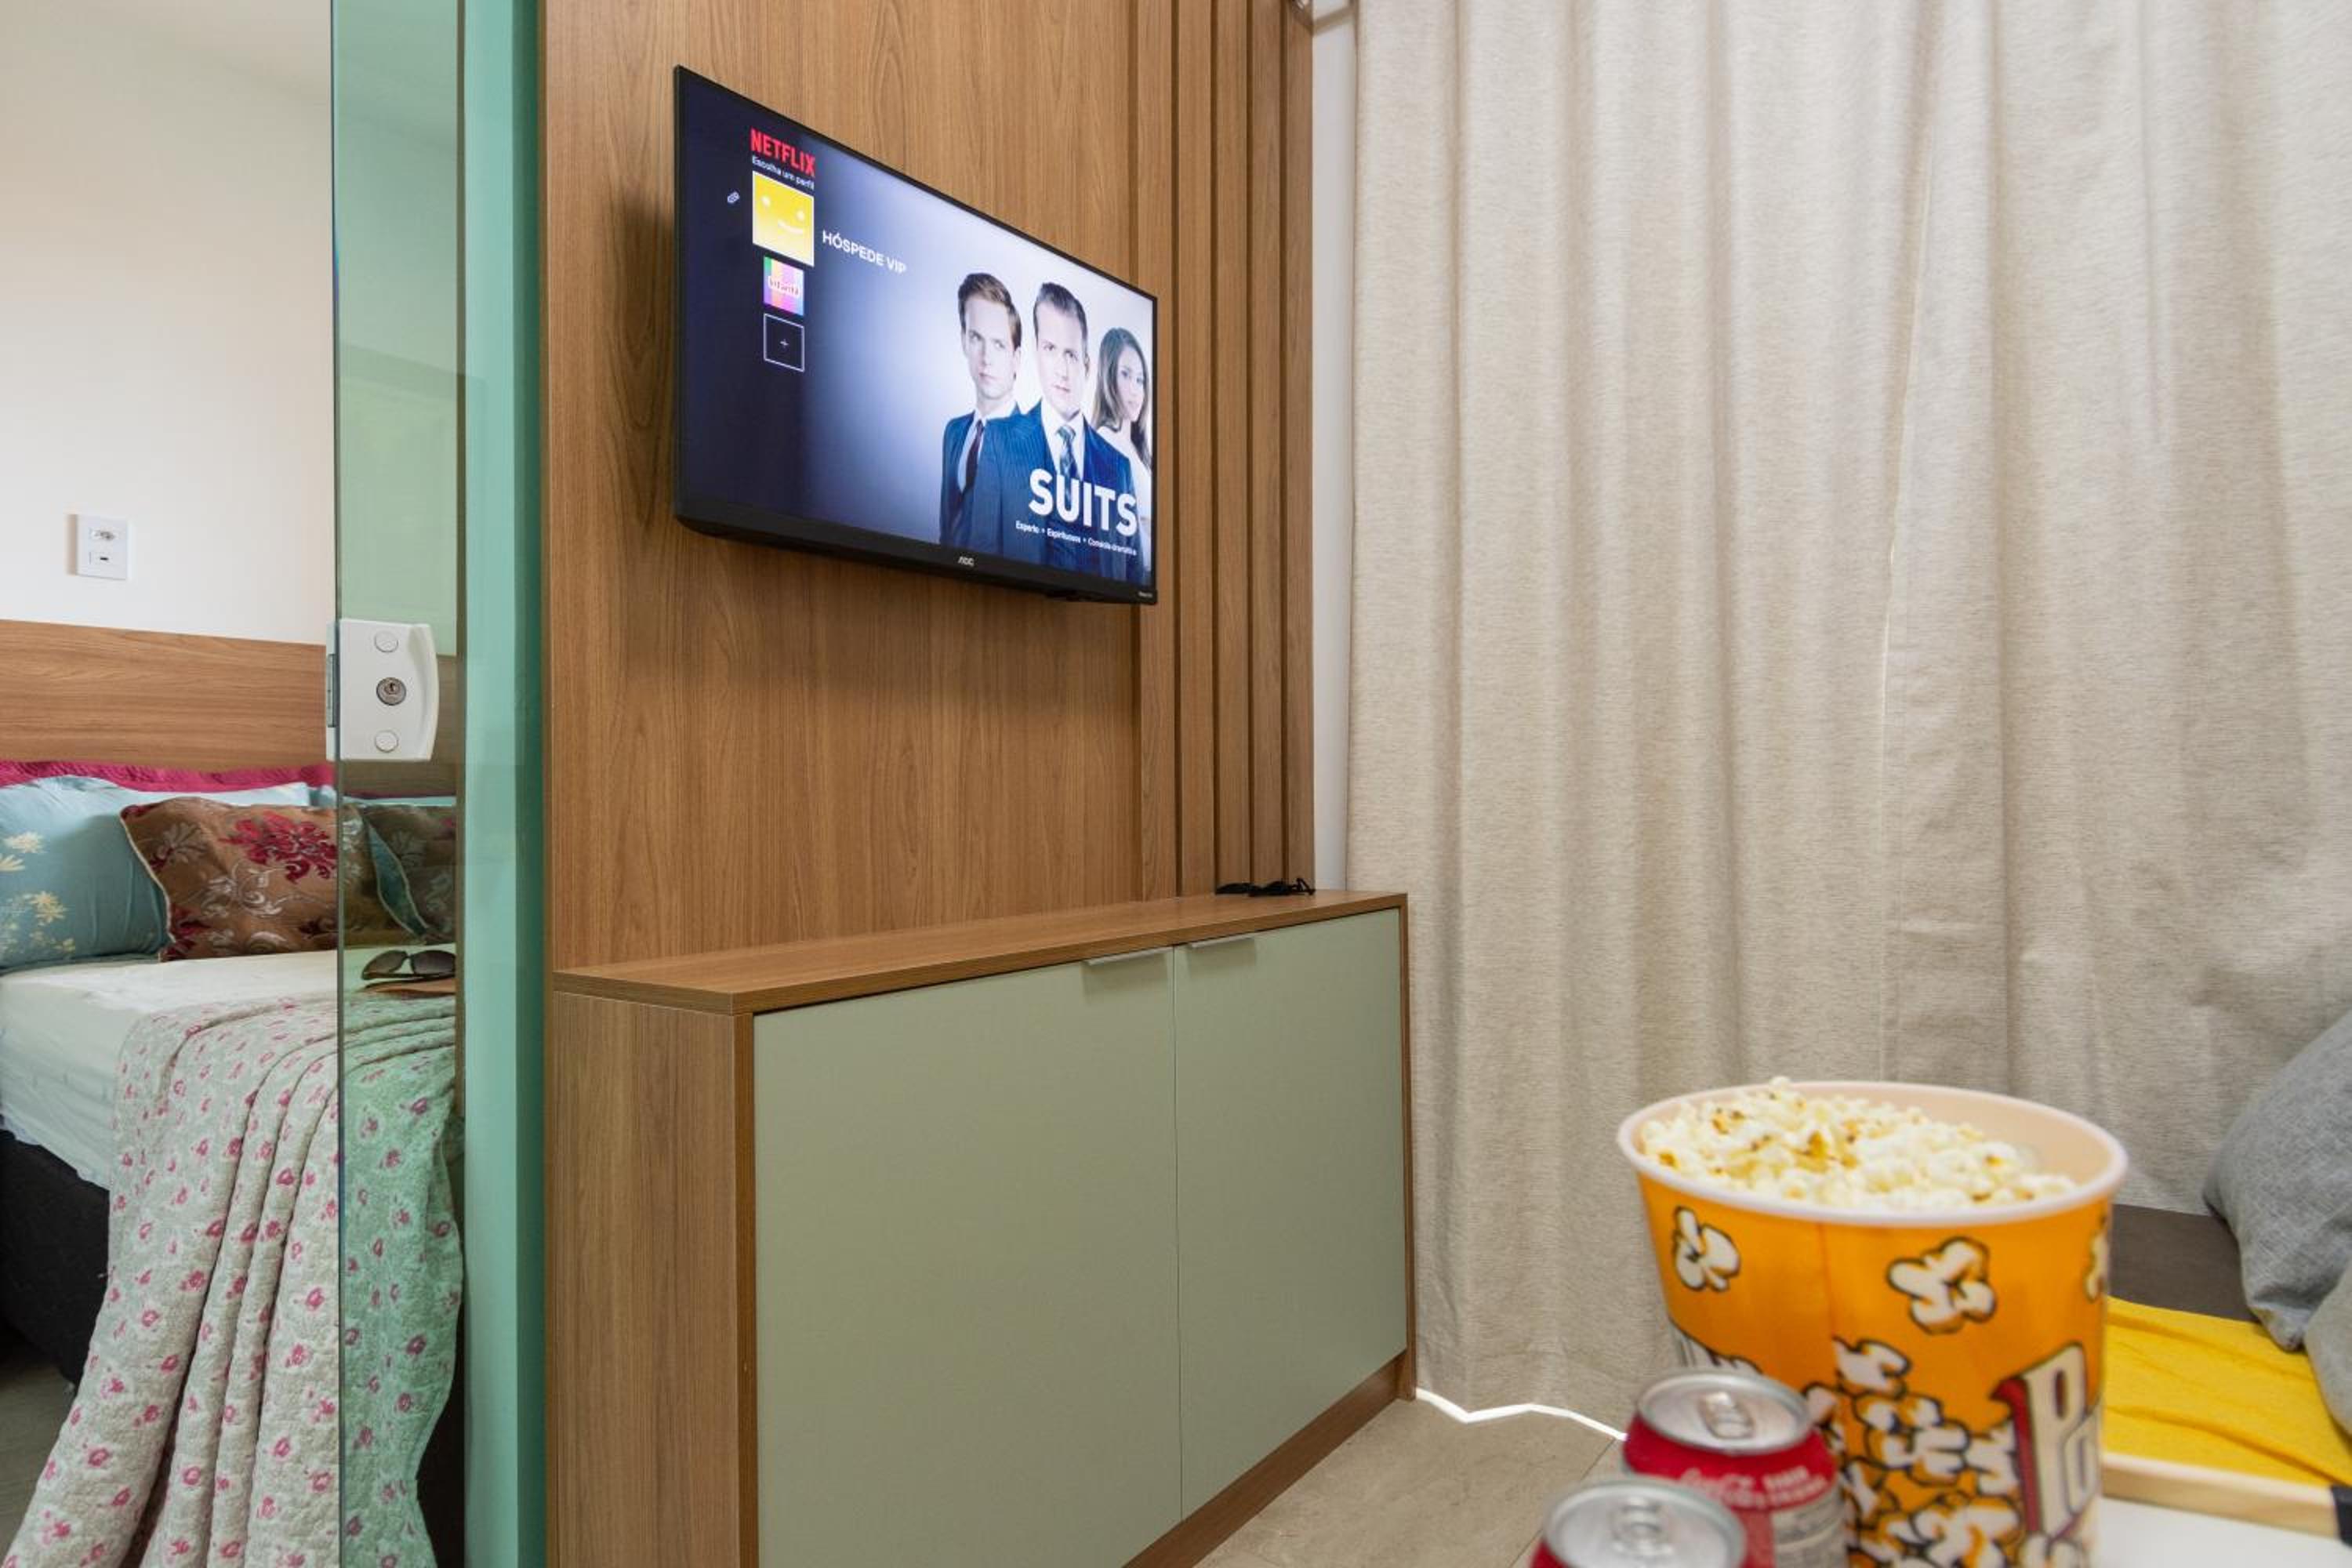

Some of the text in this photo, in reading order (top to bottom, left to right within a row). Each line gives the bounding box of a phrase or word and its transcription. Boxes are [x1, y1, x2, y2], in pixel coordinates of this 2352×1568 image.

[750, 127, 815, 177] NETFLIX
[822, 229, 907, 274] HÓSPEDE VIP
[1029, 468, 1138, 537] SUITS
